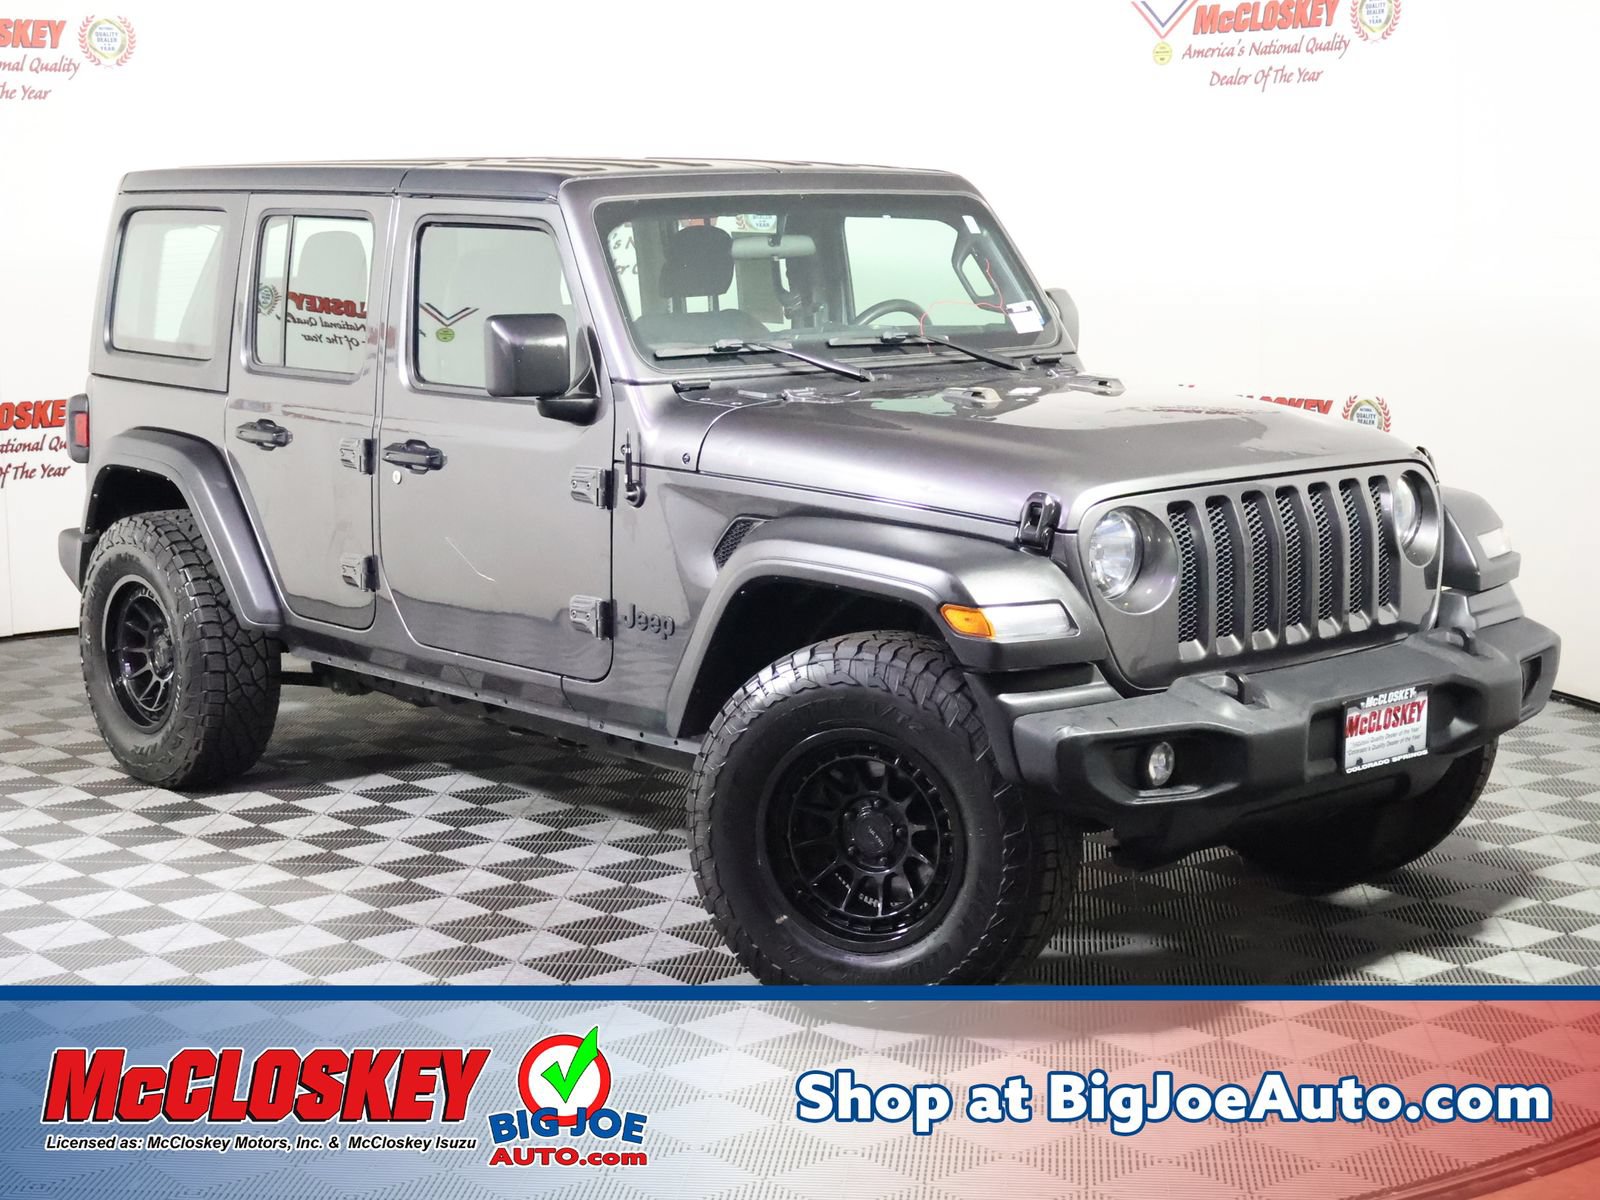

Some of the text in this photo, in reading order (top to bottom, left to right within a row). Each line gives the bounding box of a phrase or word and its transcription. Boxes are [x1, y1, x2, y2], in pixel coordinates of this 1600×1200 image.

[1193, 0, 1341, 35] McCLOSKEY
[1182, 39, 1245, 60] America's
[1249, 35, 1304, 56] National
[1305, 32, 1351, 60] Quality
[29, 55, 80, 81] Quality
[1209, 65, 1325, 93] Dealer Of The Year
[21, 84, 52, 101] Year
[13, 461, 37, 480] The
[40, 463, 71, 479] Year
[622, 603, 676, 640] Jeep
[1346, 701, 1427, 738] McCLOSKEY
[1345, 758, 1390, 774] COLORADO
